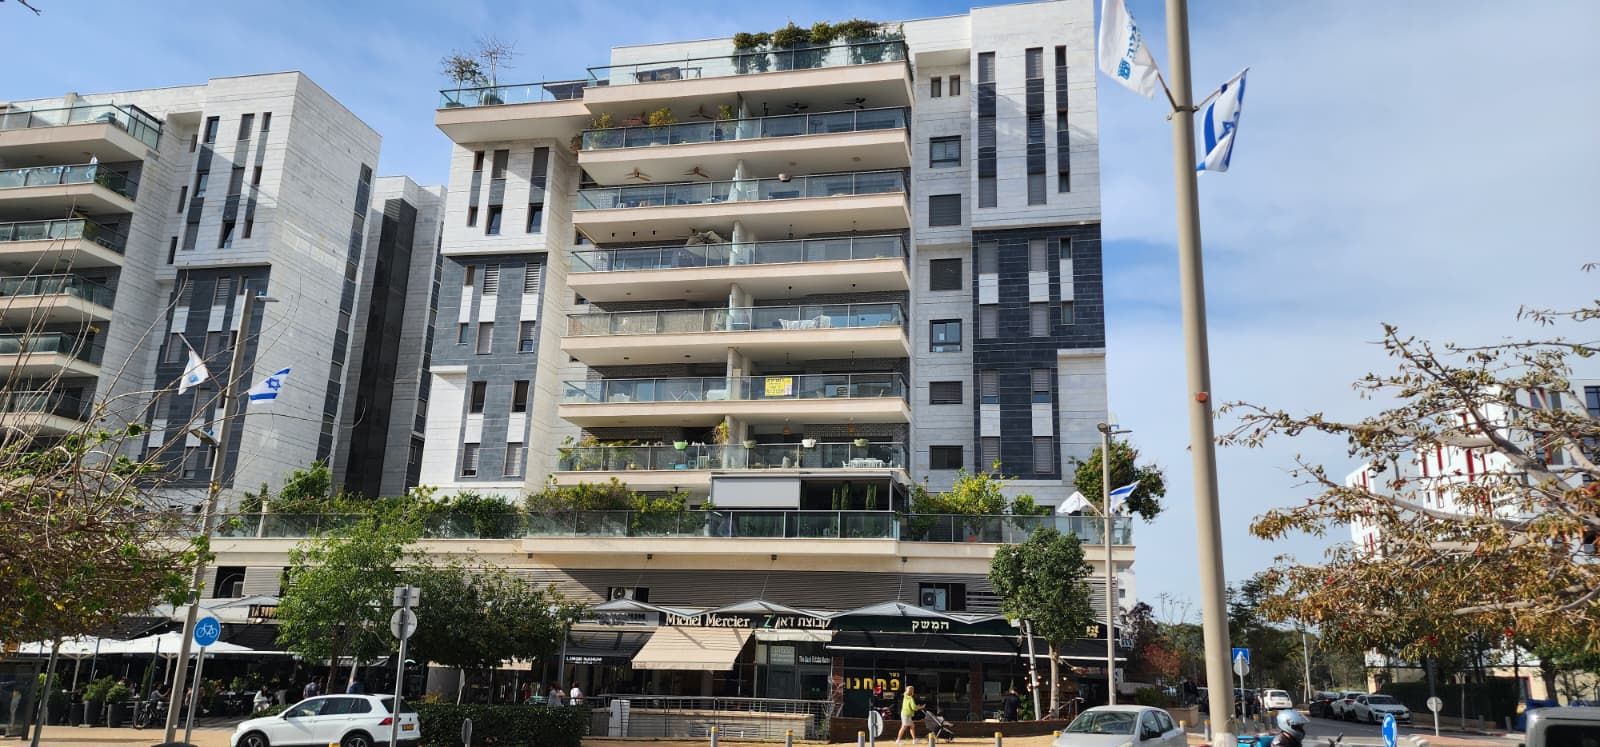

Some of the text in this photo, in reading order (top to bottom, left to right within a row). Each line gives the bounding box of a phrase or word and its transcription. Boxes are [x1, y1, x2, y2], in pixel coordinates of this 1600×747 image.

[666, 612, 750, 627] Michel Mercier
[797, 616, 832, 630] קבוצת
[846, 677, 900, 691] פתחנו
